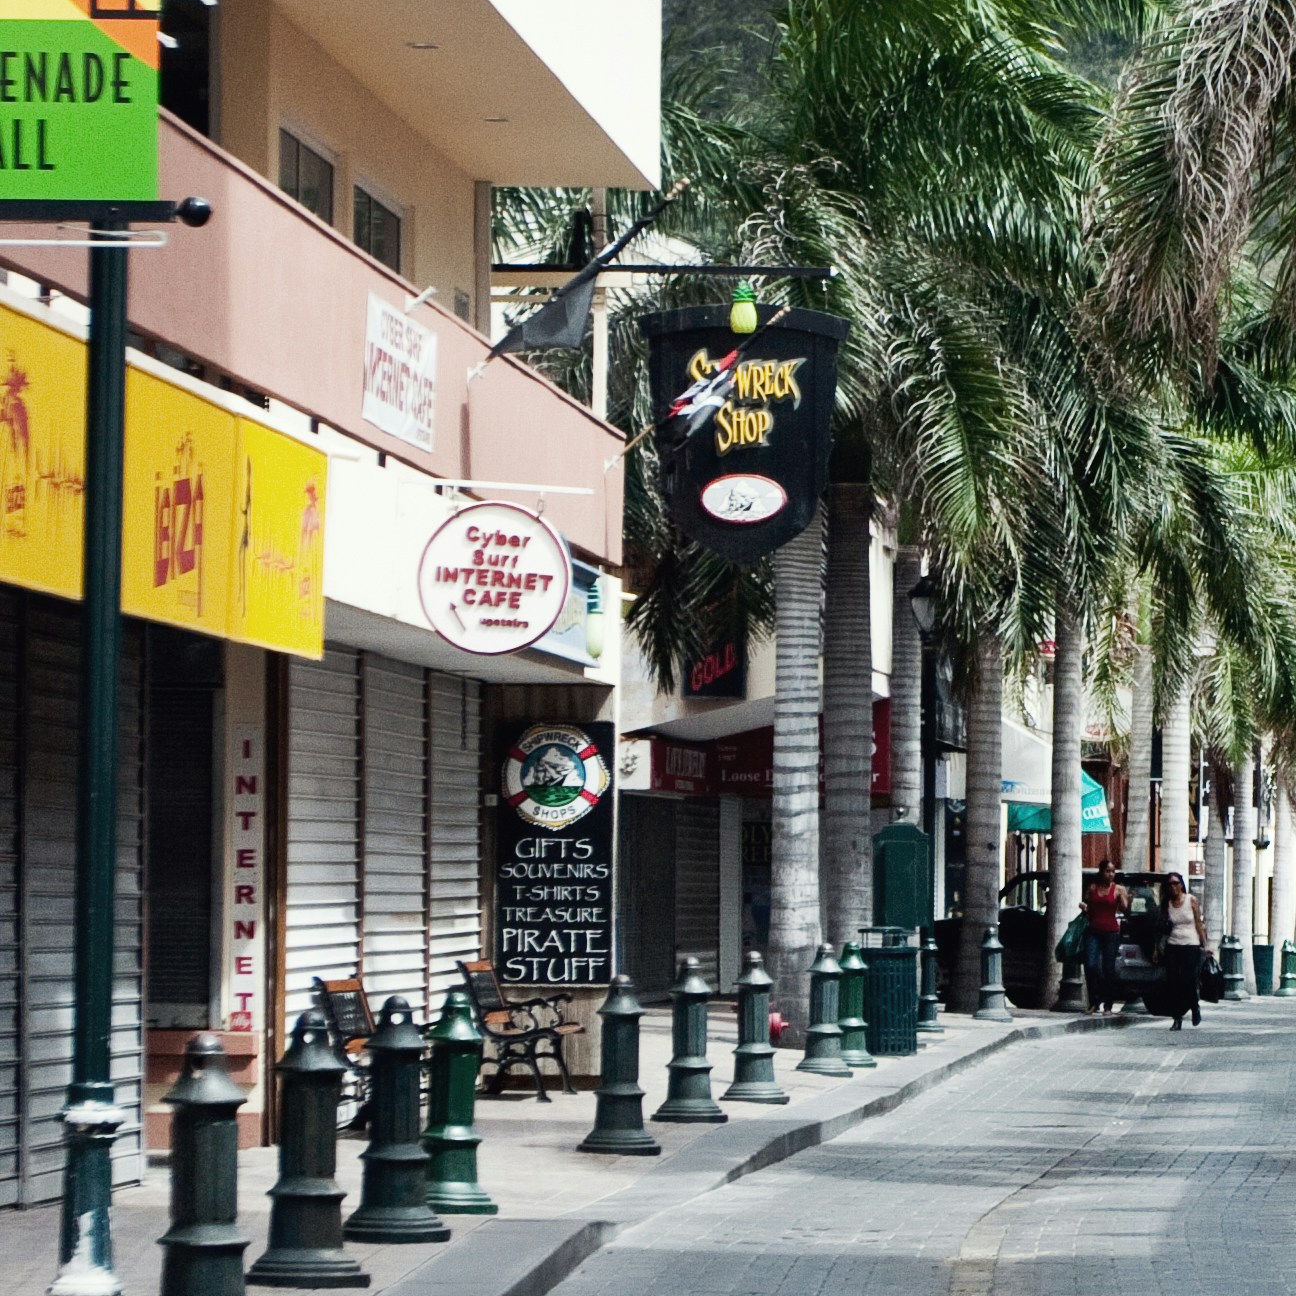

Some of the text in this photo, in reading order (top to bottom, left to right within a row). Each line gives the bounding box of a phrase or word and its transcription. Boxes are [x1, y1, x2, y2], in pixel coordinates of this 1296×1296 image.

[718, 401, 772, 452] SHOP
[465, 525, 532, 549] Cyber
[472, 549, 520, 567] Surf
[435, 566, 554, 593] INTERNET
[463, 588, 523, 610] CAFE
[521, 732, 583, 753] SHIPWRECK
[532, 805, 577, 820] SHOPS
[515, 837, 594, 859] GIFTS
[233, 739, 257, 1012] INTERNET
[499, 862, 610, 880] SOUVENIRS
[512, 885, 601, 902] T-SHIRTS
[501, 906, 608, 923] TREASURE
[502, 927, 609, 953] PIRATE
[502, 956, 606, 982] STUFF
